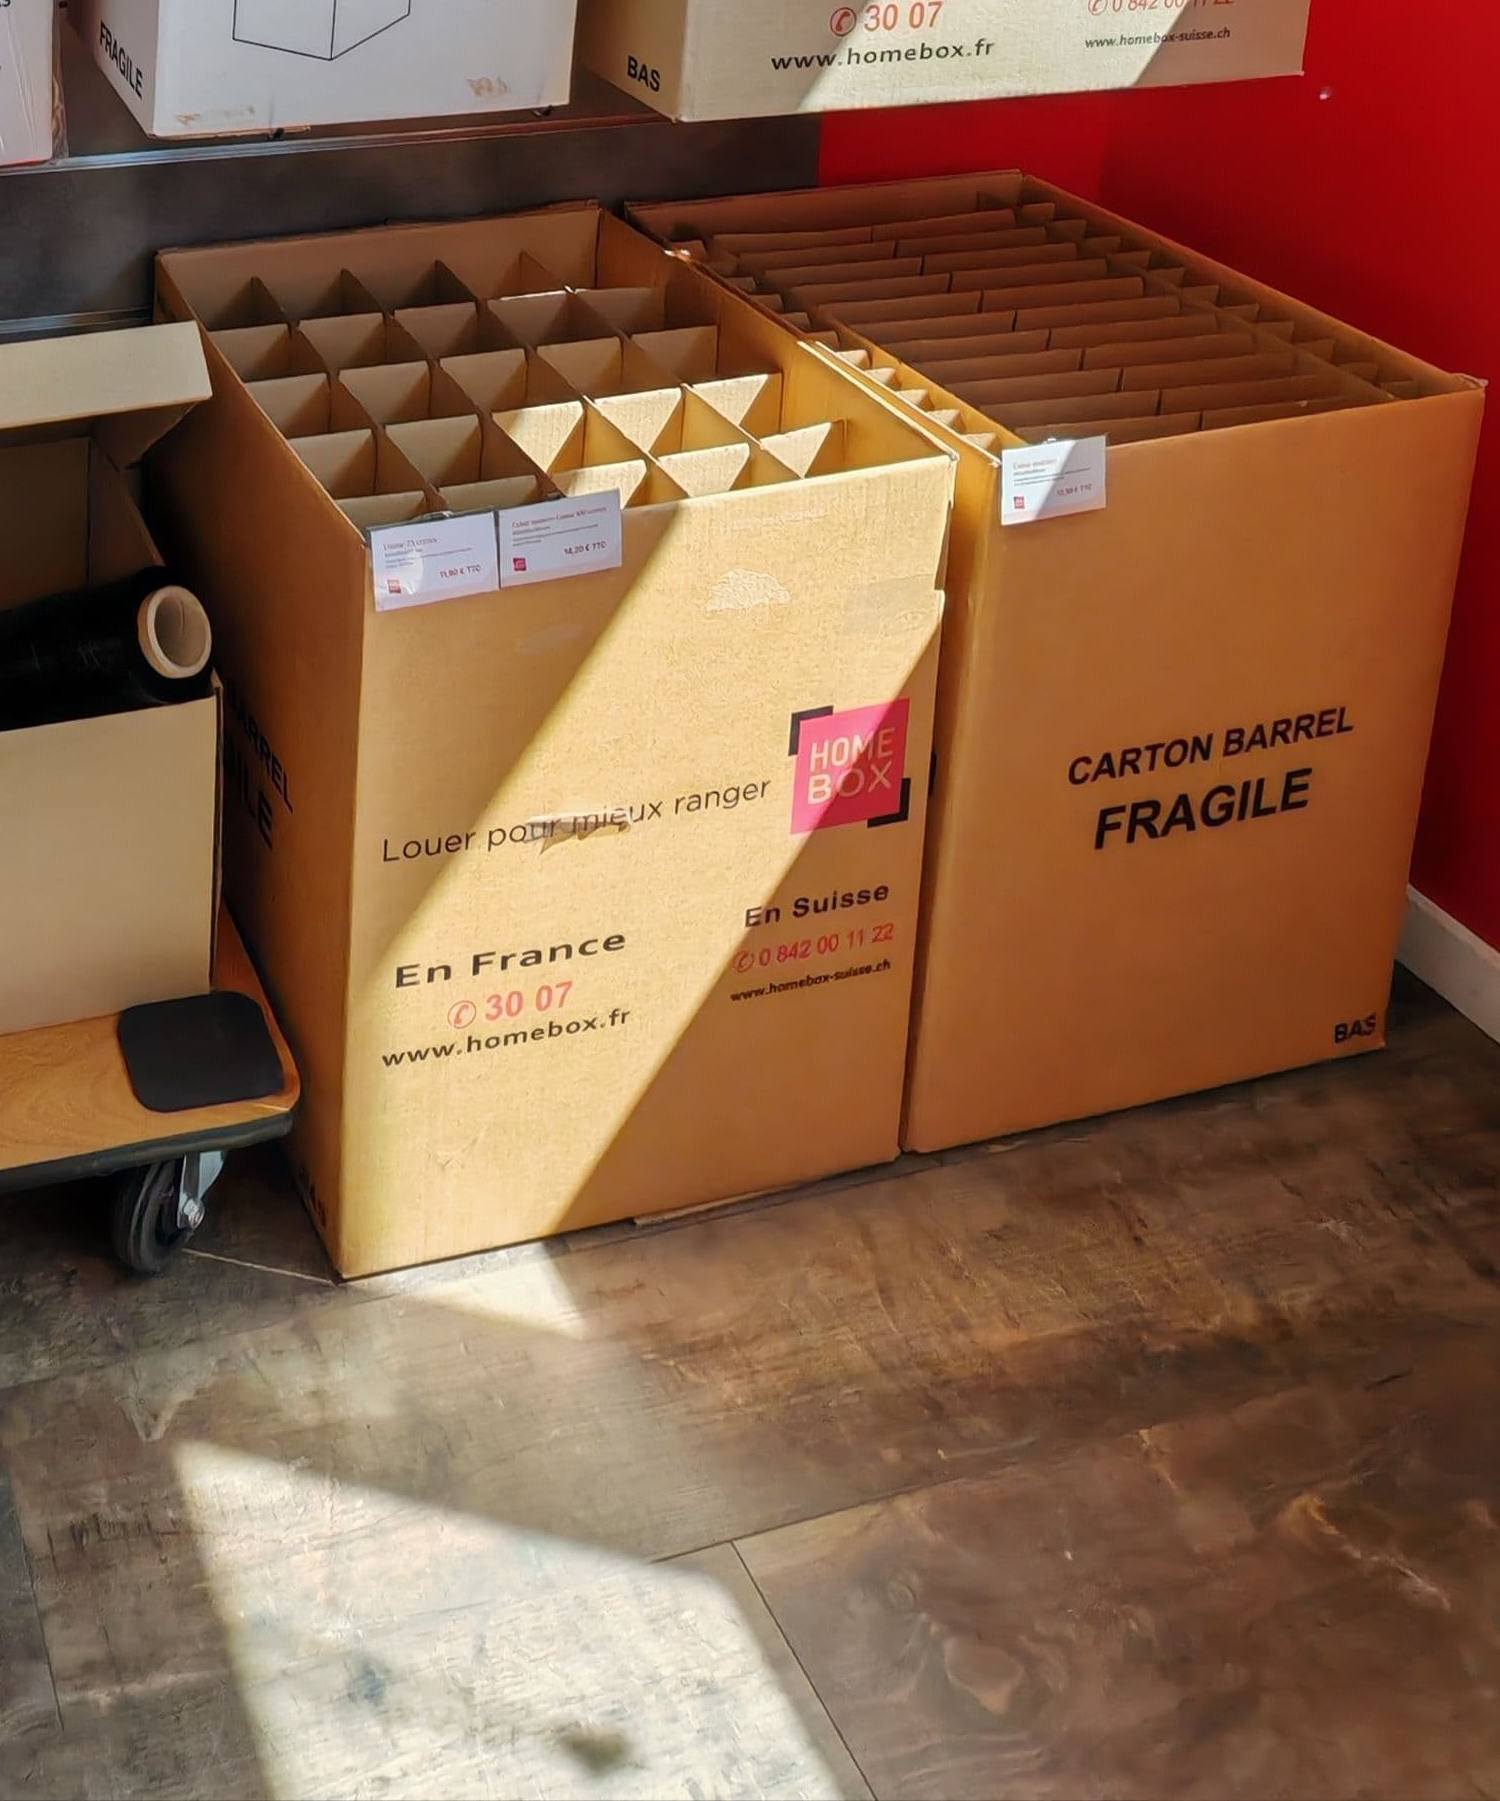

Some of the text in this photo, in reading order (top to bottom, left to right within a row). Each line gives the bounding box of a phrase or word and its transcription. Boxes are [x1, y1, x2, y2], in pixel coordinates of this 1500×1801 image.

[865, 1, 943, 31] 30 07
[99, 20, 143, 99] FRAGILE
[771, 38, 994, 70] www.homebox.fr
[1085, 28, 1230, 48] www.homebox-suisse.ch
[627, 55, 661, 92] BAS
[809, 727, 896, 771] HOME
[1068, 707, 1353, 785] CARTON BARREL
[807, 761, 892, 806] BOX
[383, 778, 771, 863] Louer pour mieux ranger
[1094, 768, 1312, 850] FRAGILE
[745, 885, 889, 927] En Suisse
[395, 931, 626, 989] En France
[760, 923, 894, 966] 0 842 00 11 22
[485, 981, 573, 1022] 30 07
[730, 959, 891, 1001] www.homebox-suisse.ch
[383, 1008, 631, 1068] www.homebox.fr
[1334, 1013, 1376, 1043] BAS
